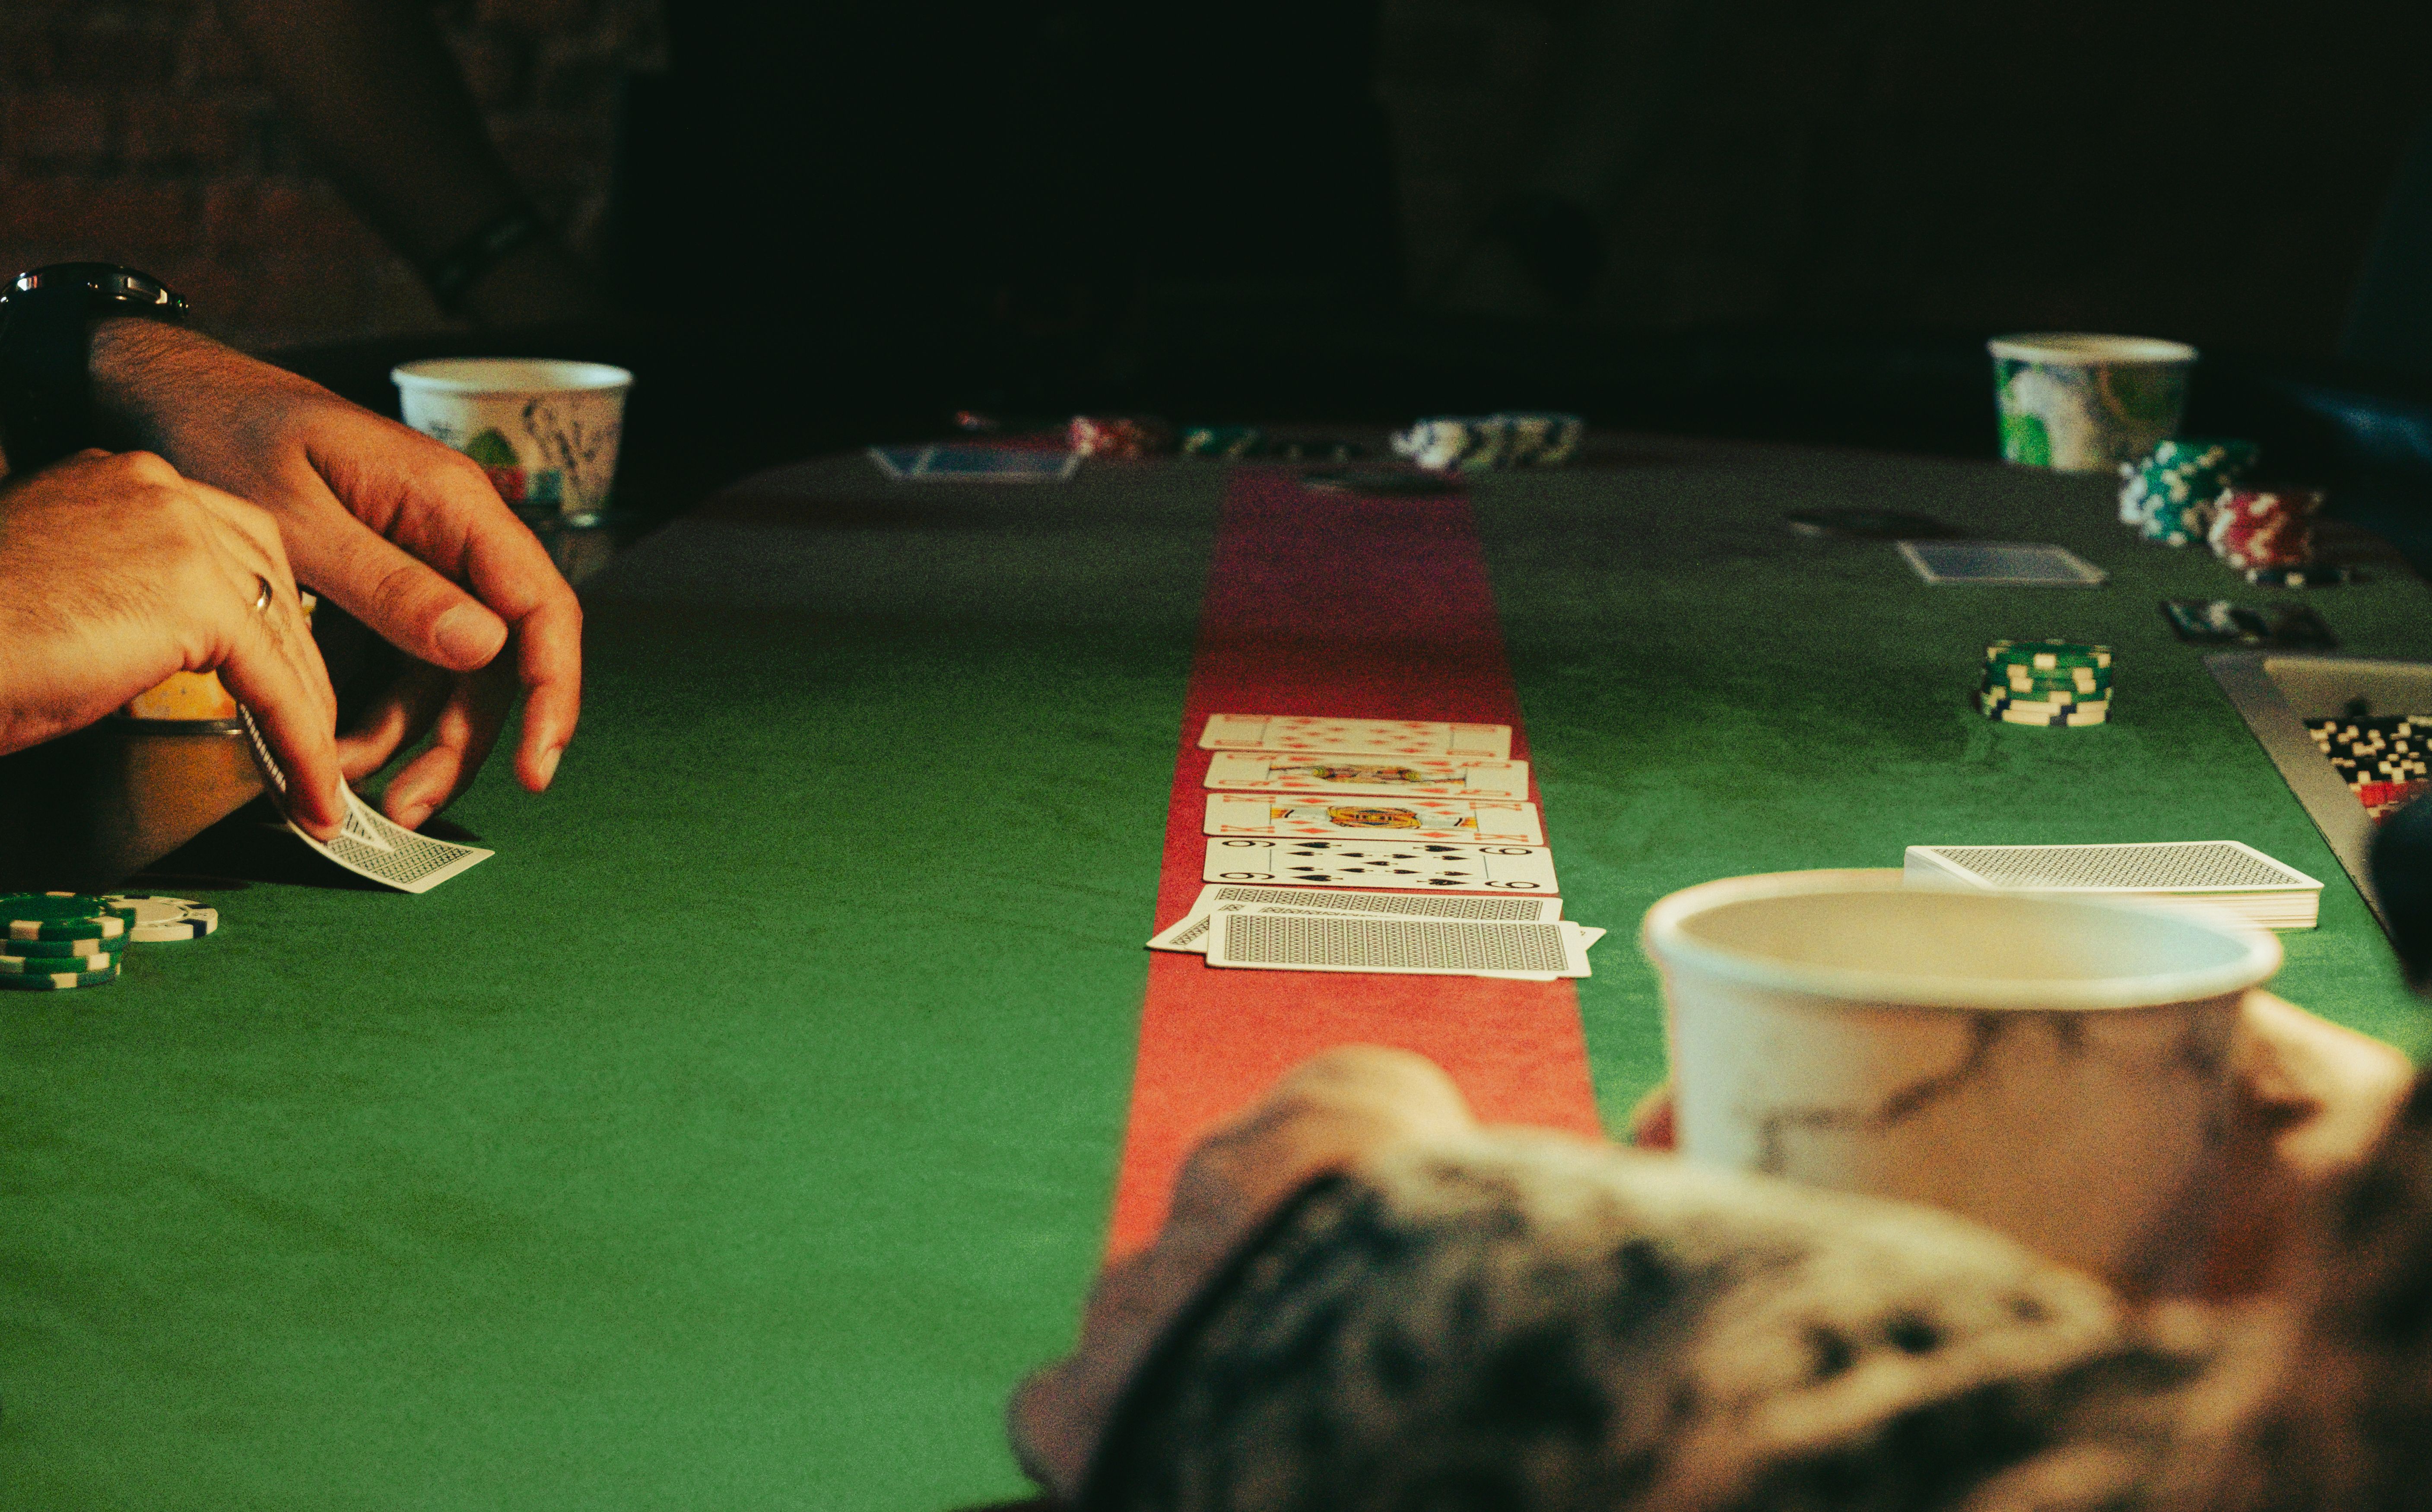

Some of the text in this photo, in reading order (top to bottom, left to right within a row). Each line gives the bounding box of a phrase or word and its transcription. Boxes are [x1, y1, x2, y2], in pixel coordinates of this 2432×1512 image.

[1223, 795, 1276, 803] K
[1469, 802, 1522, 811] K
[1220, 824, 1275, 833] K
[1474, 832, 1529, 842] K
